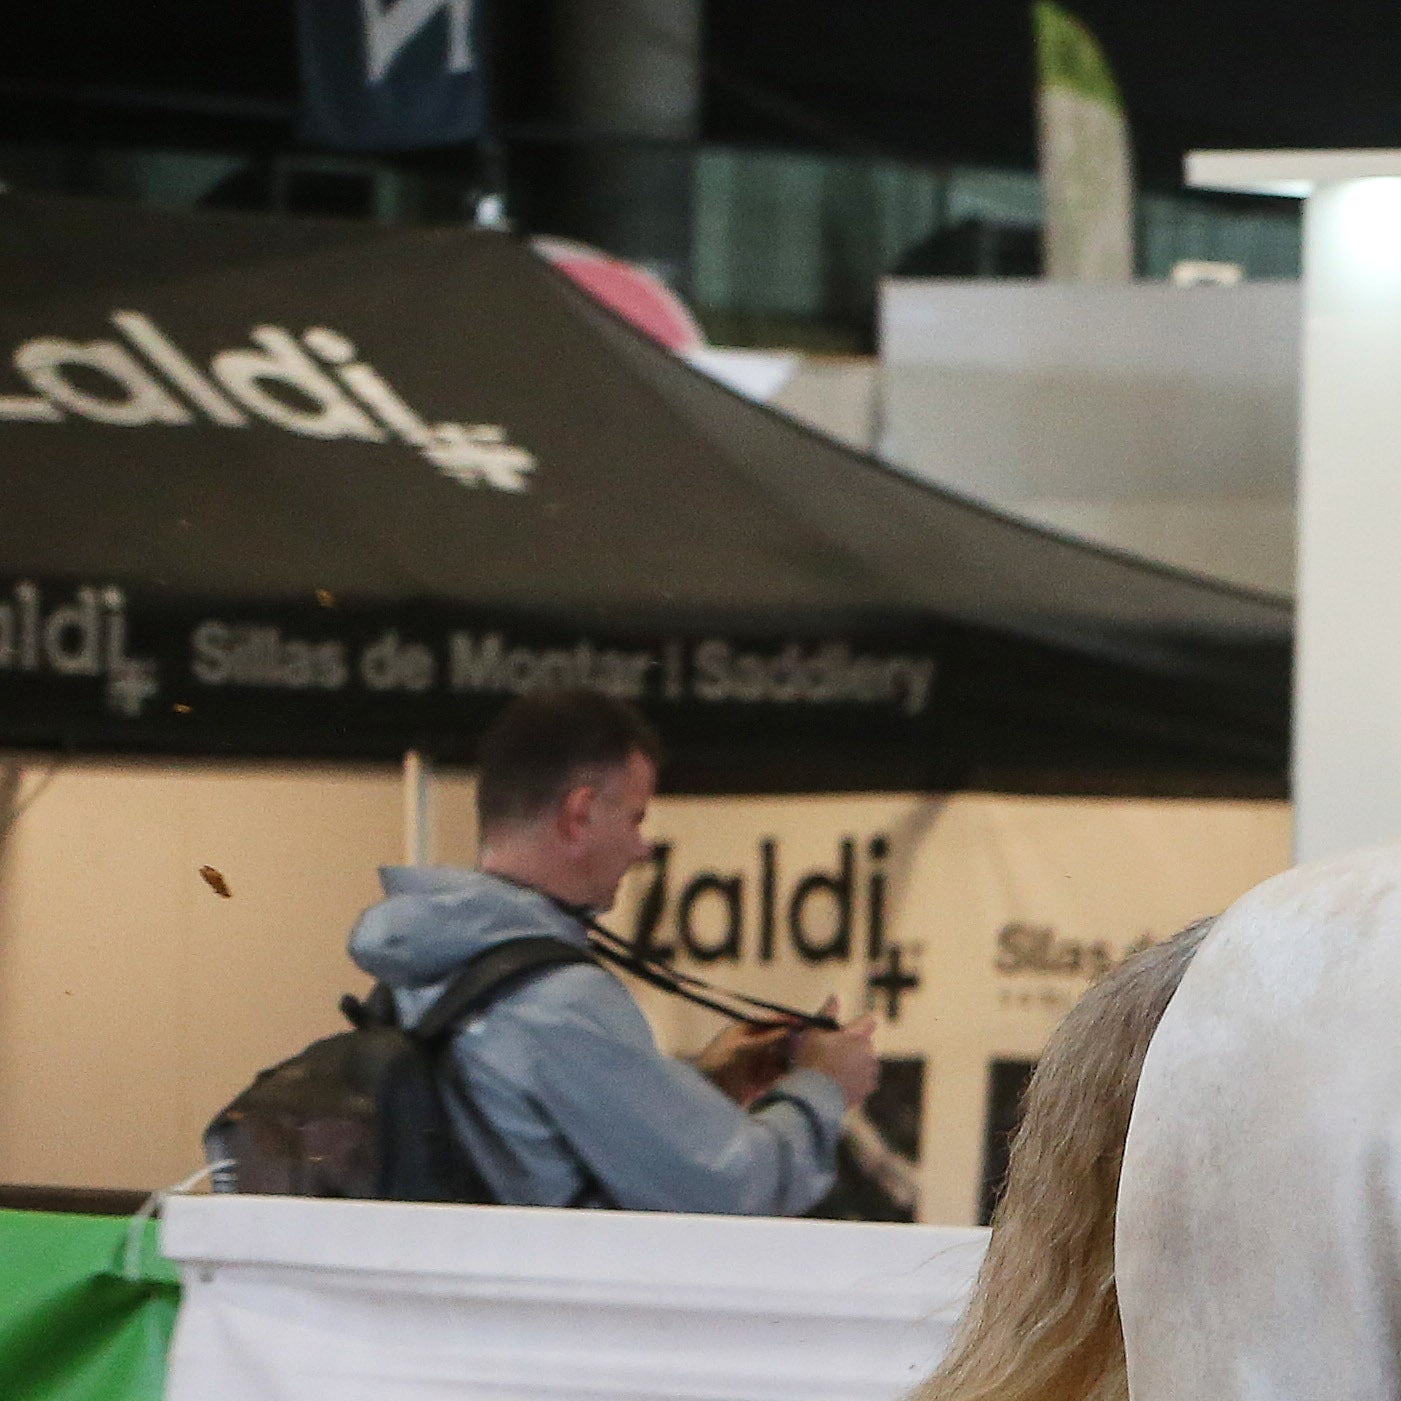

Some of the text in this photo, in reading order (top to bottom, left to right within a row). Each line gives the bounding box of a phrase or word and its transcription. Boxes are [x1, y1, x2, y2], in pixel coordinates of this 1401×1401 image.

[0, 309, 432, 447] aldi
[0, 579, 128, 678] ldi
[193, 620, 349, 689] Sillas
[360, 630, 435, 692] de
